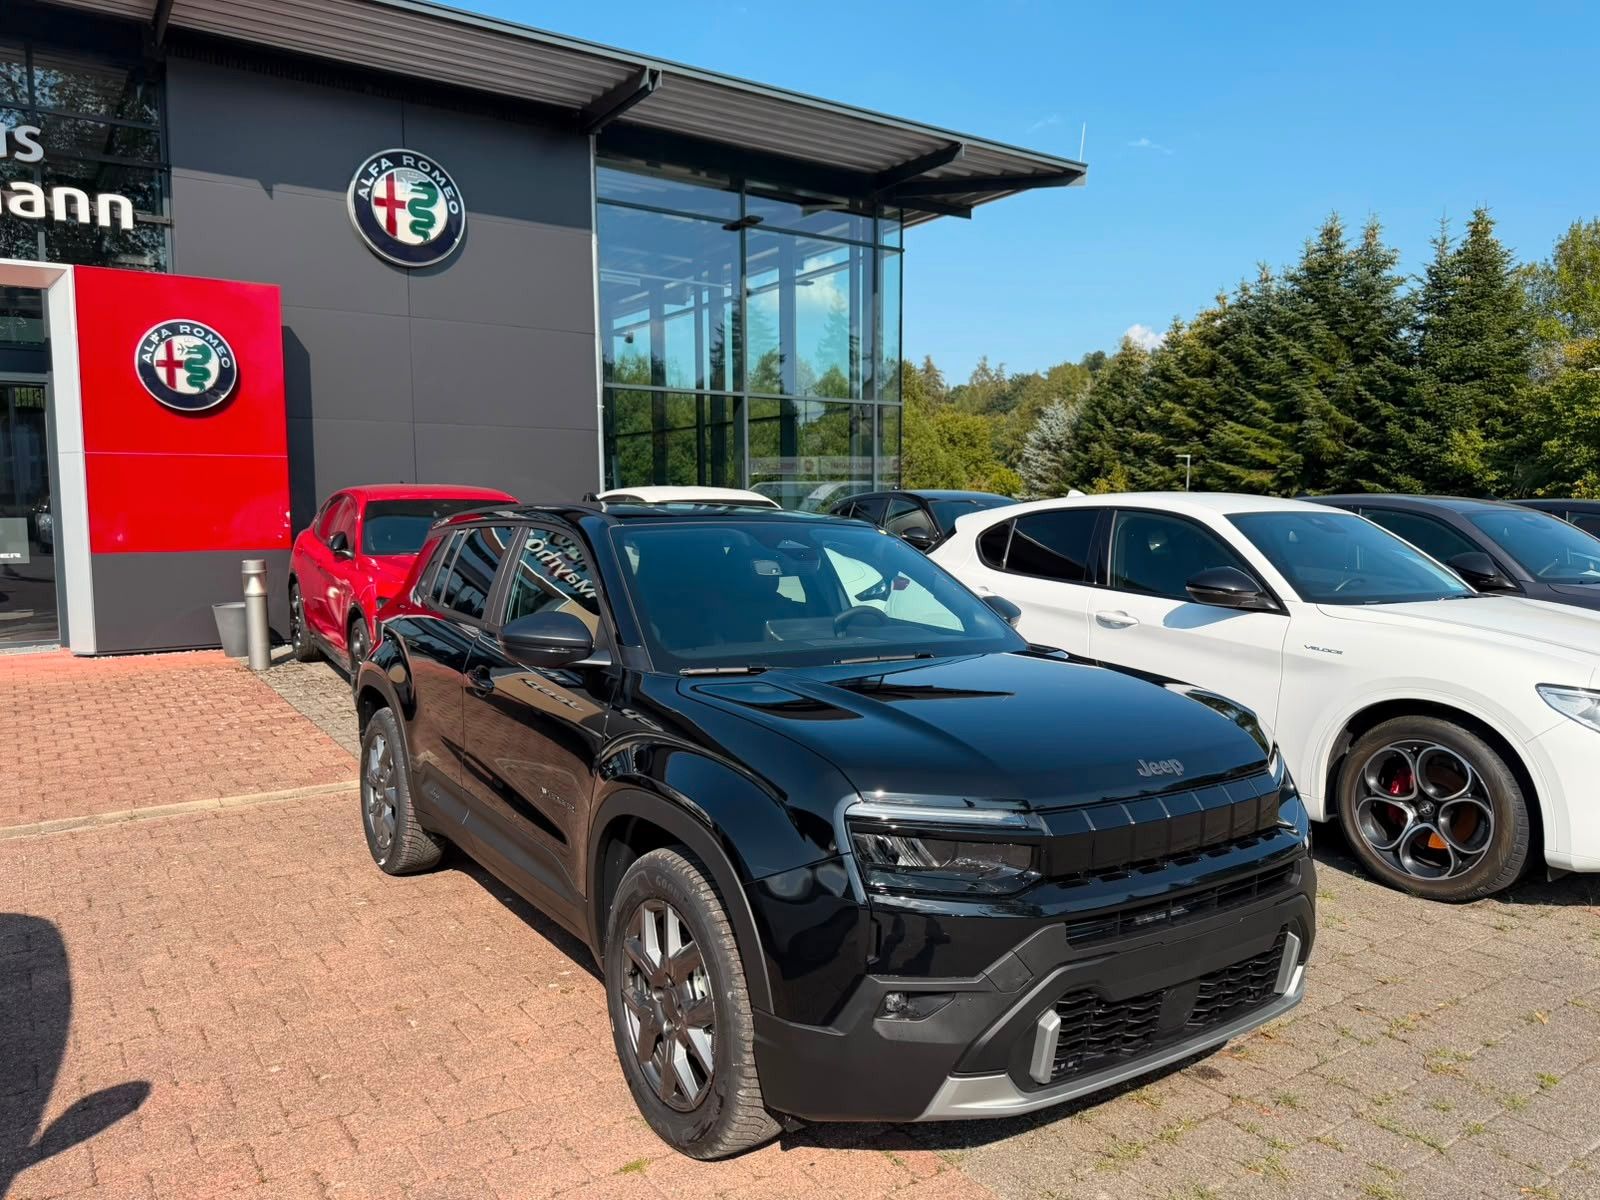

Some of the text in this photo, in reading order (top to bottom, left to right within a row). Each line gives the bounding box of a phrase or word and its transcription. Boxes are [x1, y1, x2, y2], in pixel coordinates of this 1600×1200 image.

[0, 181, 134, 231] ann
[358, 155, 459, 215] ALFA ROMEO
[142, 325, 231, 368] ALFA ROMEO
[1136, 758, 1184, 777] Jeep
